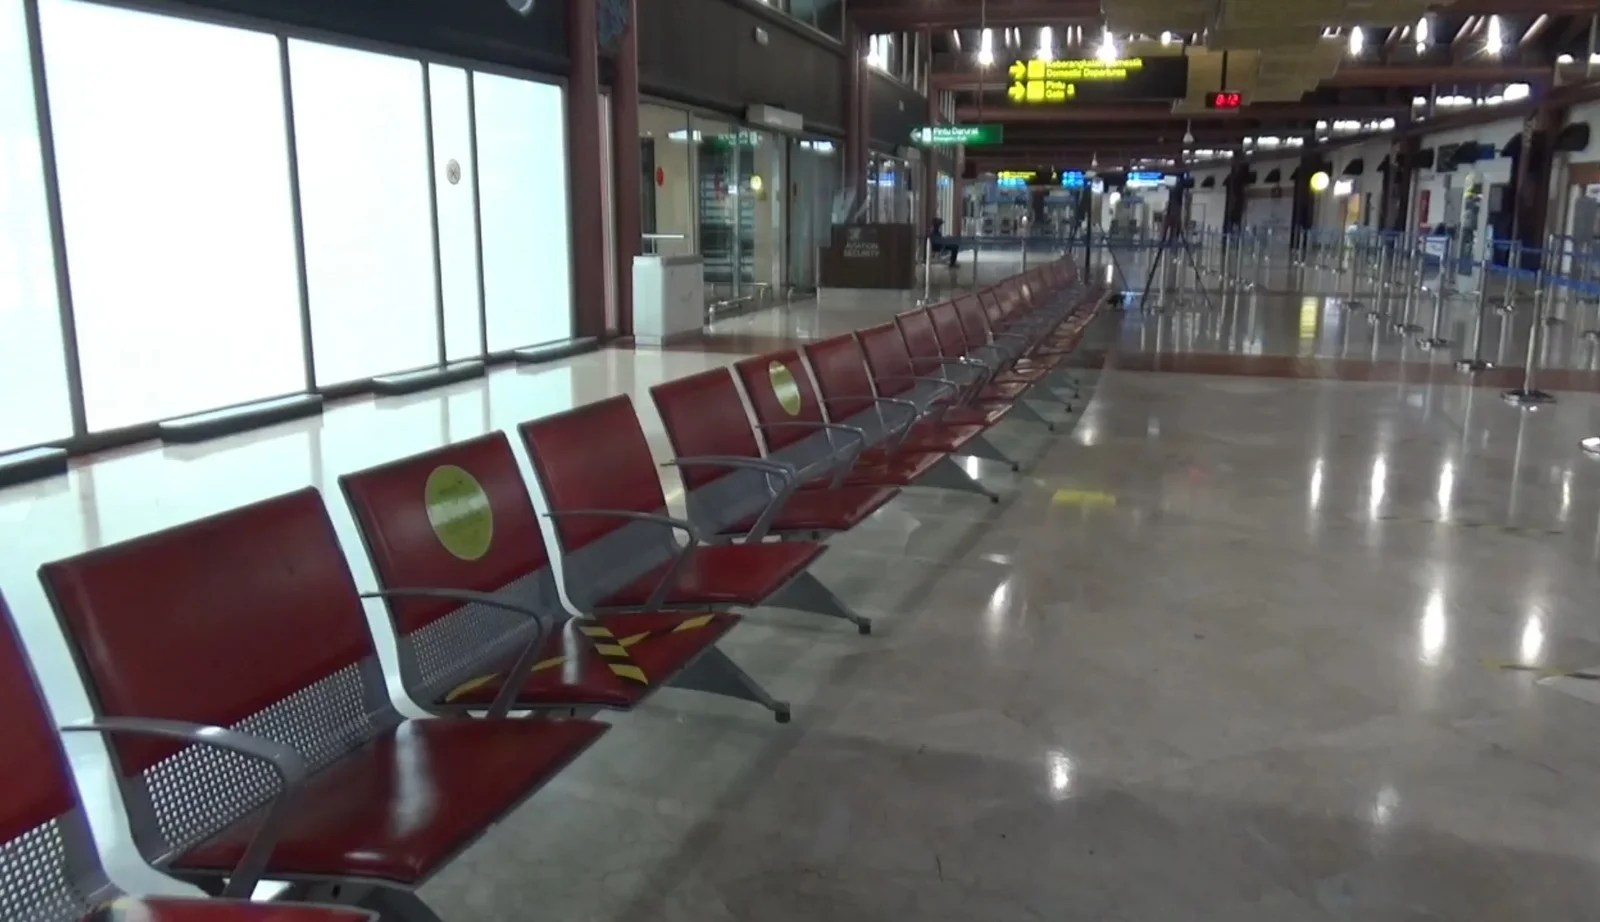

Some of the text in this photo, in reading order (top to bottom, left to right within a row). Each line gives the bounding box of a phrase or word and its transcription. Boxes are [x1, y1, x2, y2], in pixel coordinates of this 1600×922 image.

[1083, 68, 1126, 78] Departures
[1046, 81, 1066, 89] Pintu
[933, 127, 979, 135] Pintu Darurat
[845, 241, 878, 249] AVIATION
[843, 249, 880, 257] SECURITY
